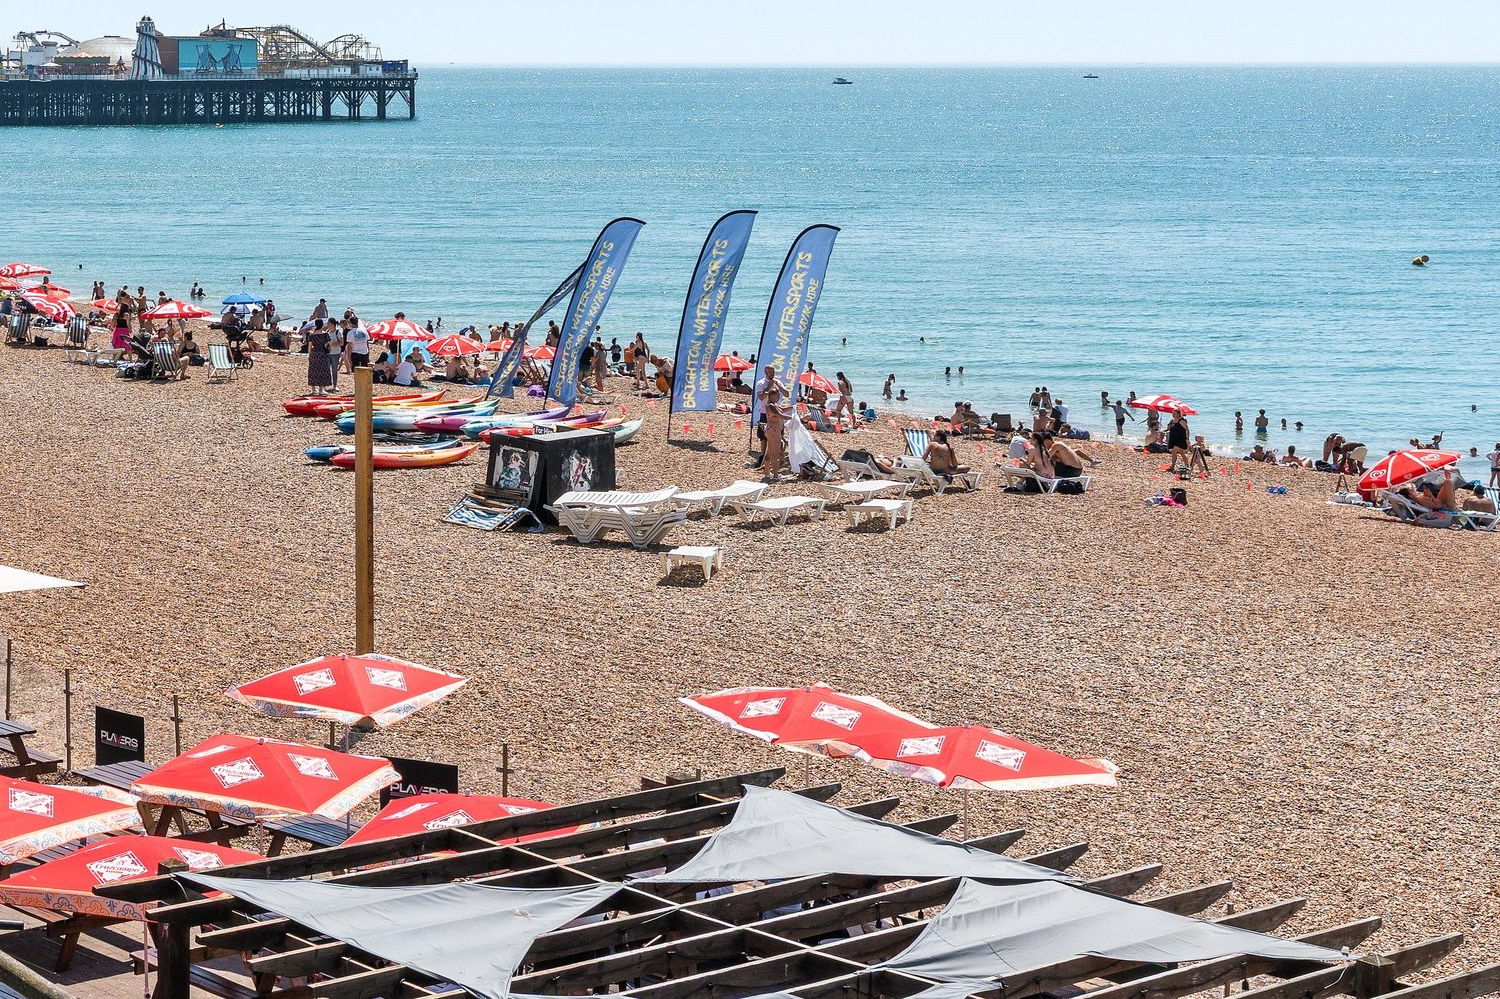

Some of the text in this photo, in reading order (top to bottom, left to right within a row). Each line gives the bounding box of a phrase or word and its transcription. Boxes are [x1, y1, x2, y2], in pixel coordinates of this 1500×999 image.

[554, 240, 614, 397] BRIGHTON WATERSPORTS
[585, 319, 593, 327] &
[587, 290, 606, 317] KAYAK
[600, 266, 615, 290] HIRE
[682, 239, 728, 409] BRIGHTON WATERSPORTS
[775, 251, 812, 350] WATERSPORTS
[699, 331, 718, 392] PADDLEBOARD
[713, 289, 726, 319] KAYAK
[720, 264, 734, 287] HIRE
[780, 278, 819, 407] PADLEBOARD & KAYAK HIRE
[100, 729, 139, 748] PLAYERS
